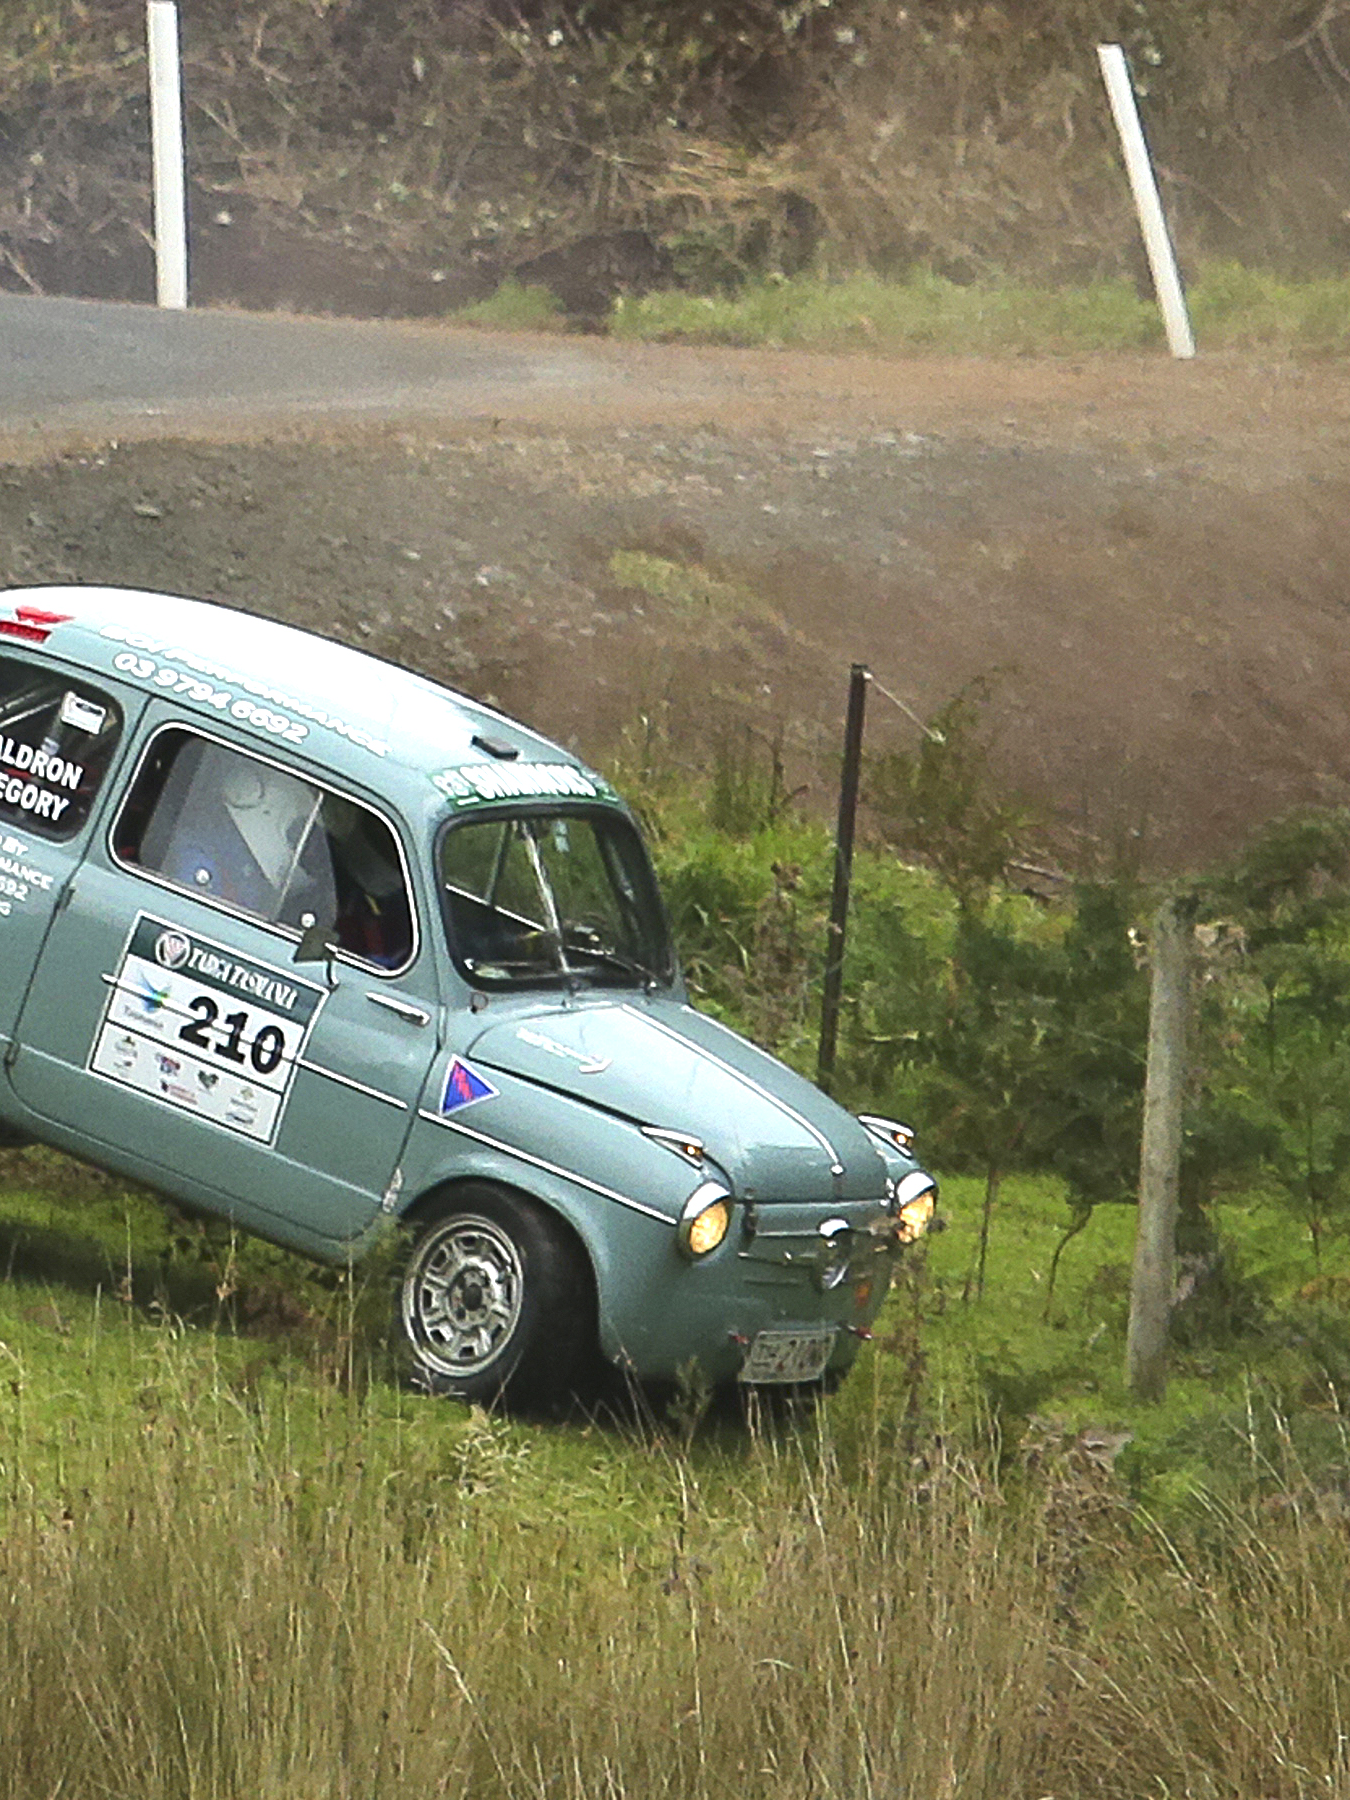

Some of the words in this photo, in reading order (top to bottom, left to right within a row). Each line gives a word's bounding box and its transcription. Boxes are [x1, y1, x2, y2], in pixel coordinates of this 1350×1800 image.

[114, 652, 156, 679] 03
[153, 668, 233, 710] 9794
[230, 699, 310, 745] 6692
[179, 996, 286, 1075] 210
